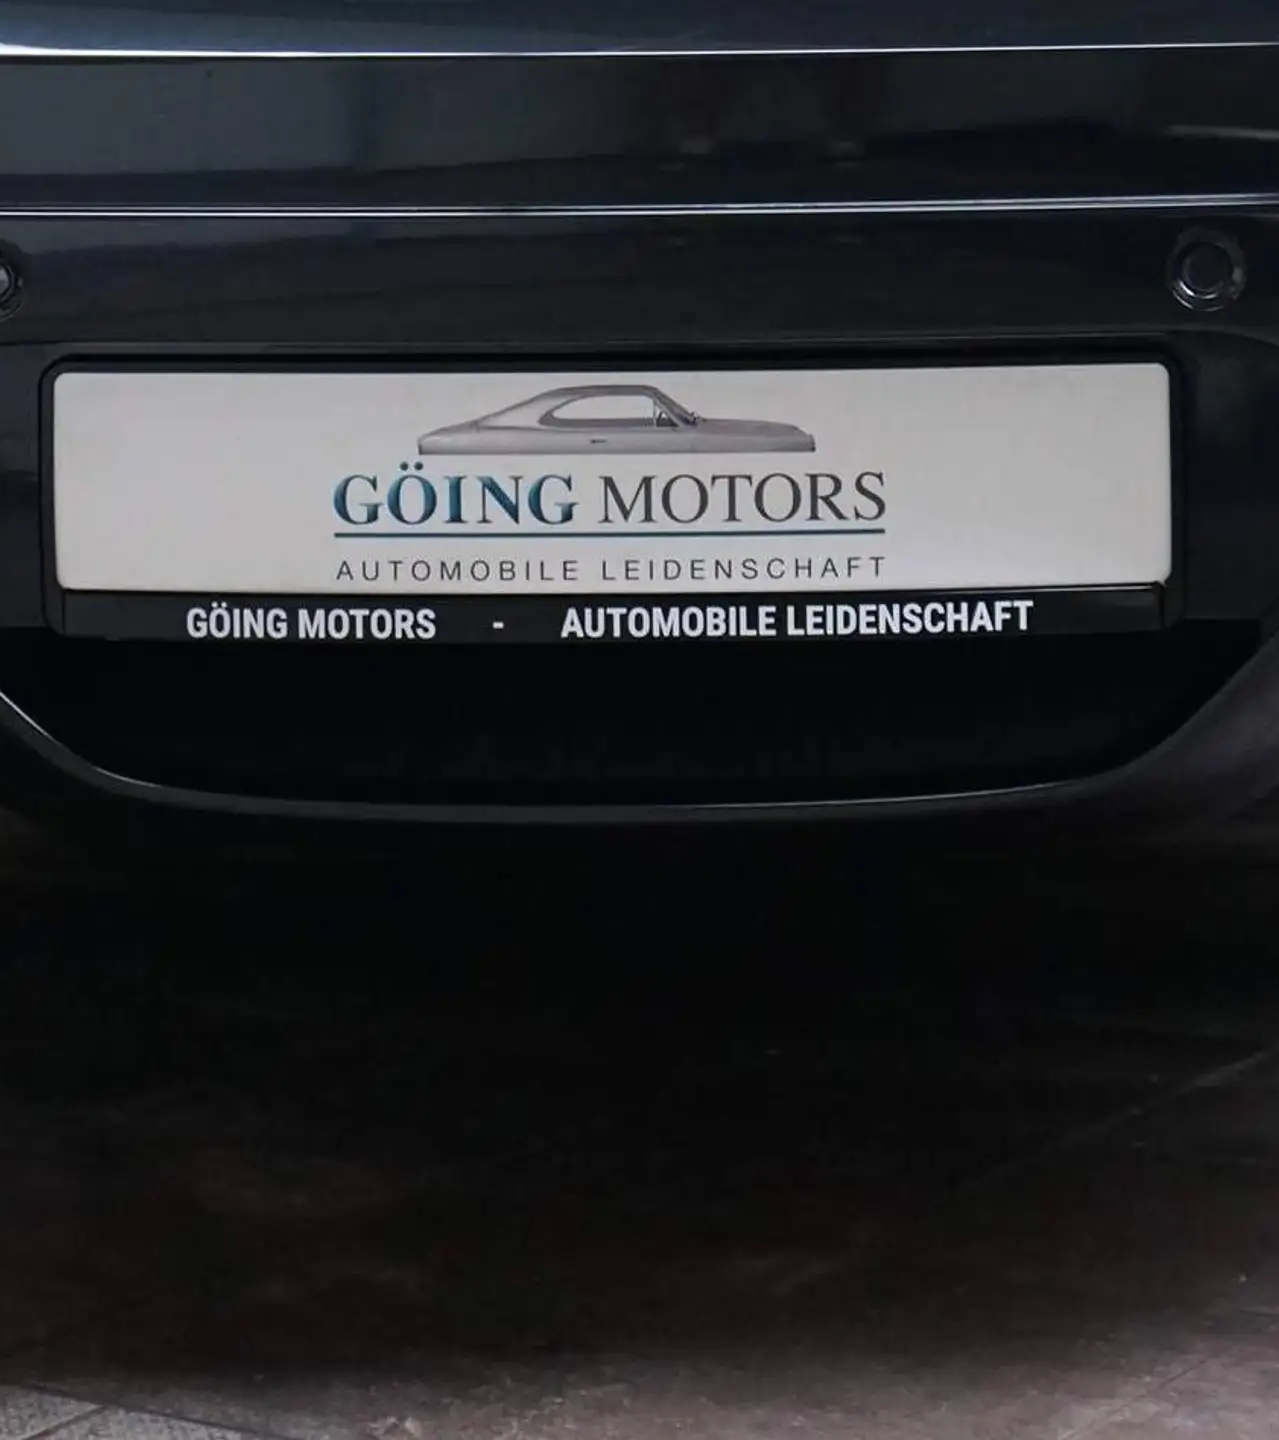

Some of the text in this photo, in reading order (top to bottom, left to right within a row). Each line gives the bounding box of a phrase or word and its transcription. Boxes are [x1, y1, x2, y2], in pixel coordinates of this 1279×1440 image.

[333, 461, 887, 526] GÖING MOTORS
[336, 555, 887, 582] AUTOMOBILE LEIDENSCHAFT
[186, 601, 288, 639] GÖING
[298, 608, 437, 640] MOTORS
[560, 604, 778, 639] AUTOMOBILE
[786, 598, 1035, 637] LEIDENSCHAFT
